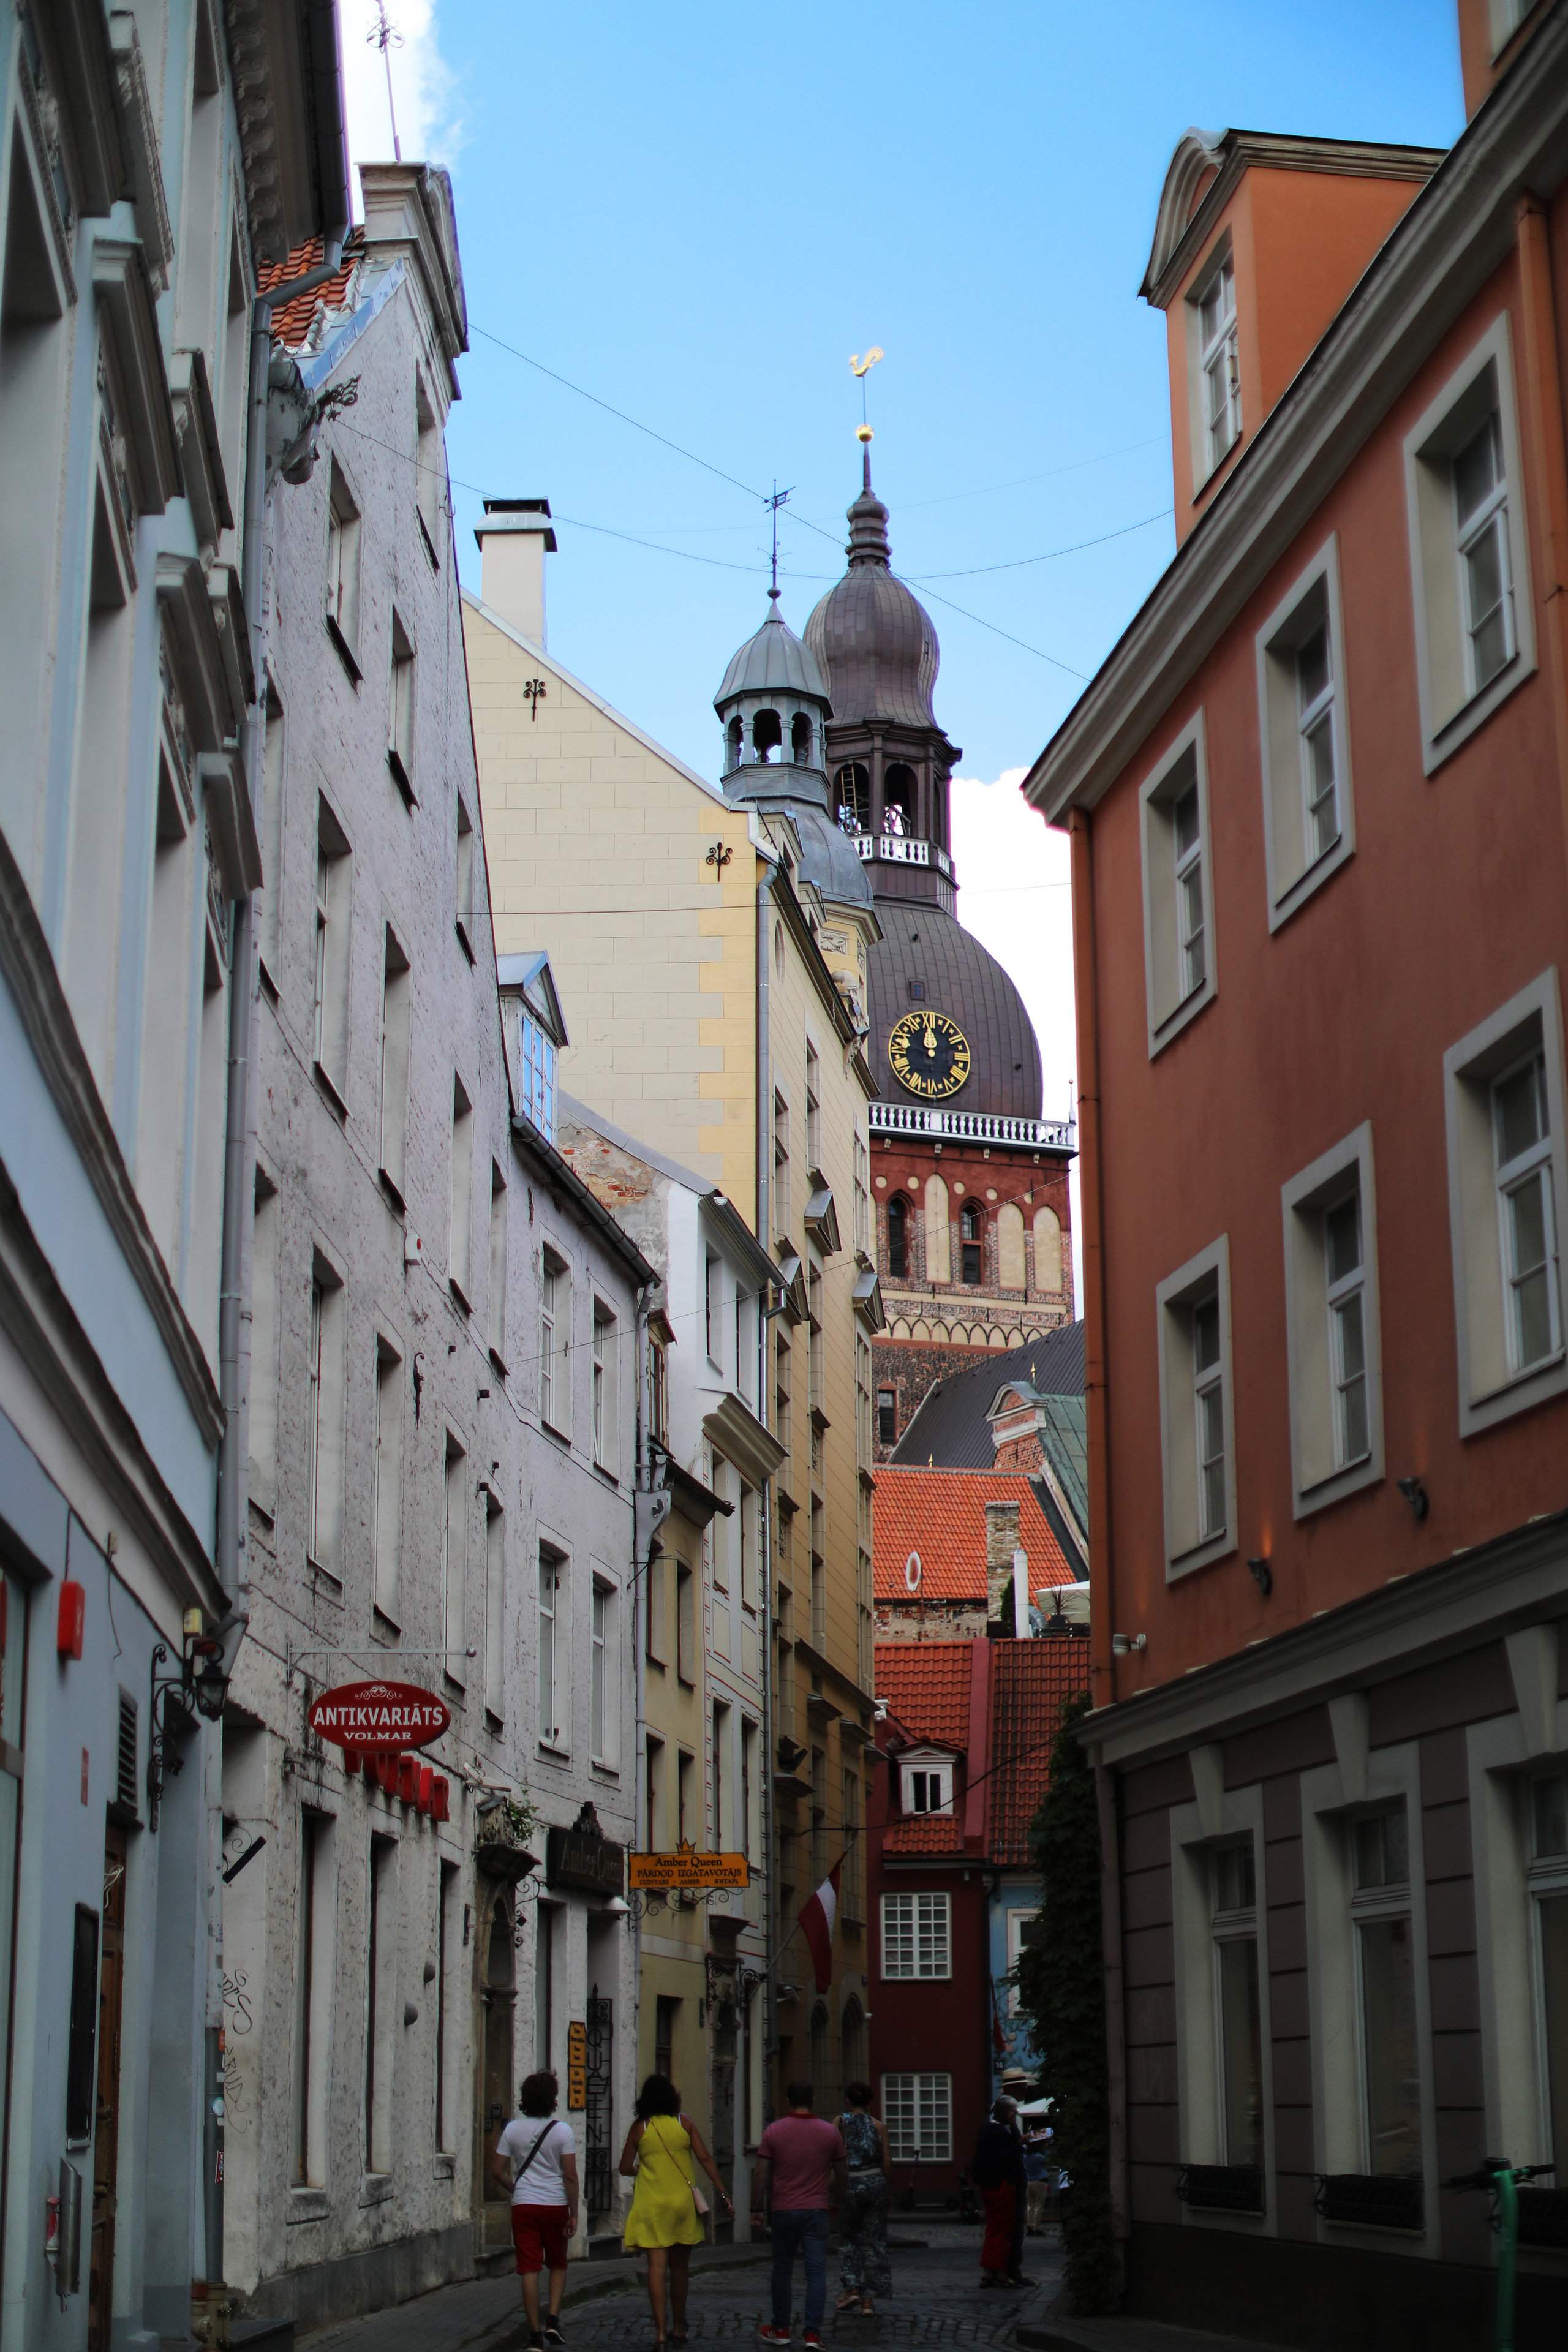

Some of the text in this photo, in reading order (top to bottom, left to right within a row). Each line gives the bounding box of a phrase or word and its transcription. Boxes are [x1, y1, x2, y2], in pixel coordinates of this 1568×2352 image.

[904, 1016, 920, 1033] XI
[922, 1012, 935, 1029] XII
[942, 1020, 951, 1034] I
[948, 1033, 963, 1045] II
[954, 1052, 969, 1061] III
[943, 1077, 954, 1092] V
[314, 1703, 443, 1725] ANTIKVARIĀTS
[560, 1835, 595, 1877] Amber
[655, 1856, 722, 1868] Amber Queen
[637, 1868, 742, 1878] PĀRDOD IZGATAVOTĀJS
